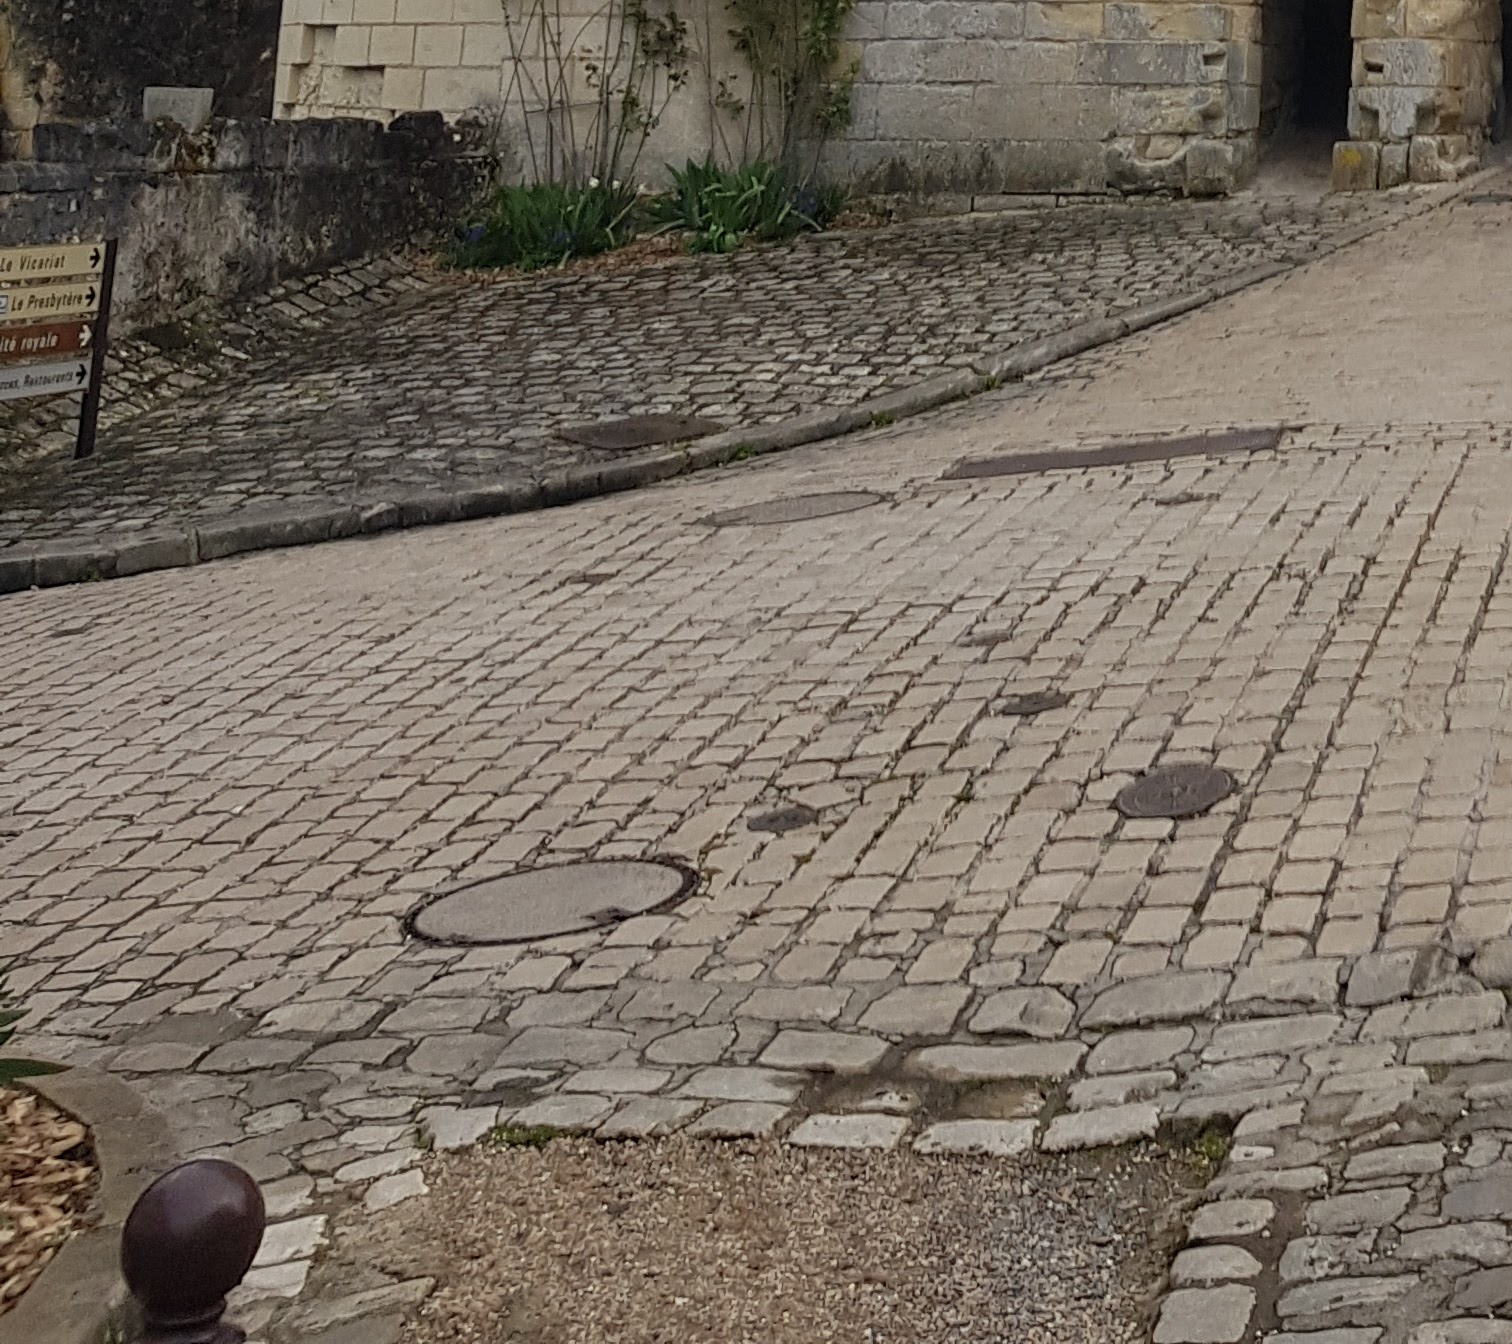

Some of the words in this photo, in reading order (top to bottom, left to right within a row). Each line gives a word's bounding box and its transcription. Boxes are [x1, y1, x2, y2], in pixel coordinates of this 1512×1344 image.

[19, 254, 66, 270] Vicariat
[27, 292, 83, 310] Presbytère
[20, 331, 59, 352] royale
